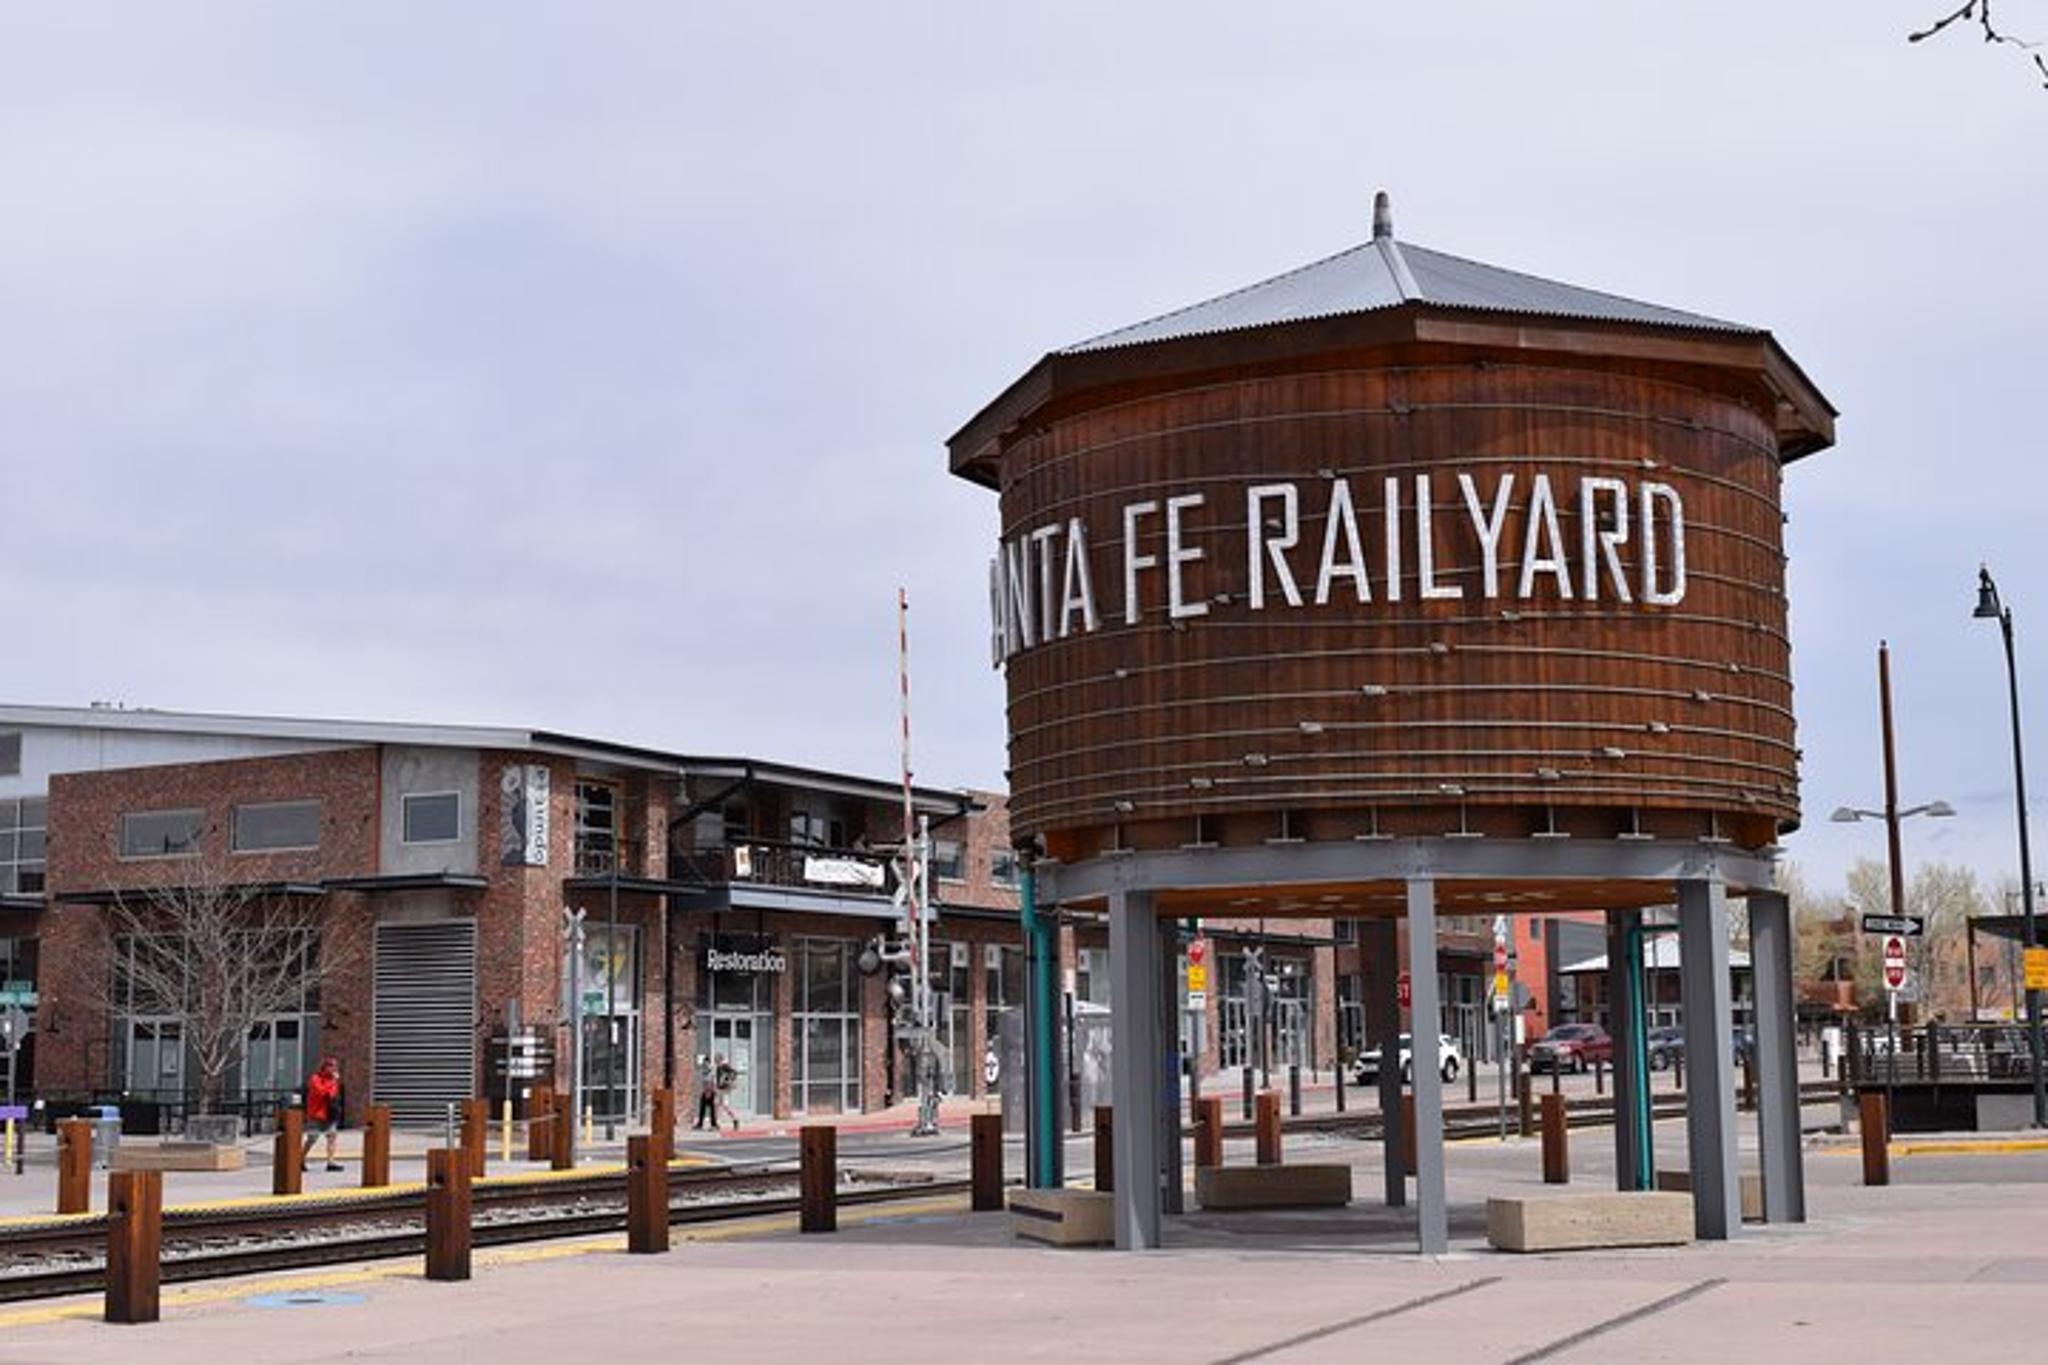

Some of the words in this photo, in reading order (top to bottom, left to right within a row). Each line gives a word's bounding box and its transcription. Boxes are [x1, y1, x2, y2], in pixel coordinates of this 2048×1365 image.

[1124, 494, 1210, 625] FE
[1247, 473, 1687, 610] RAILYARD
[707, 948, 786, 973] Restoration
